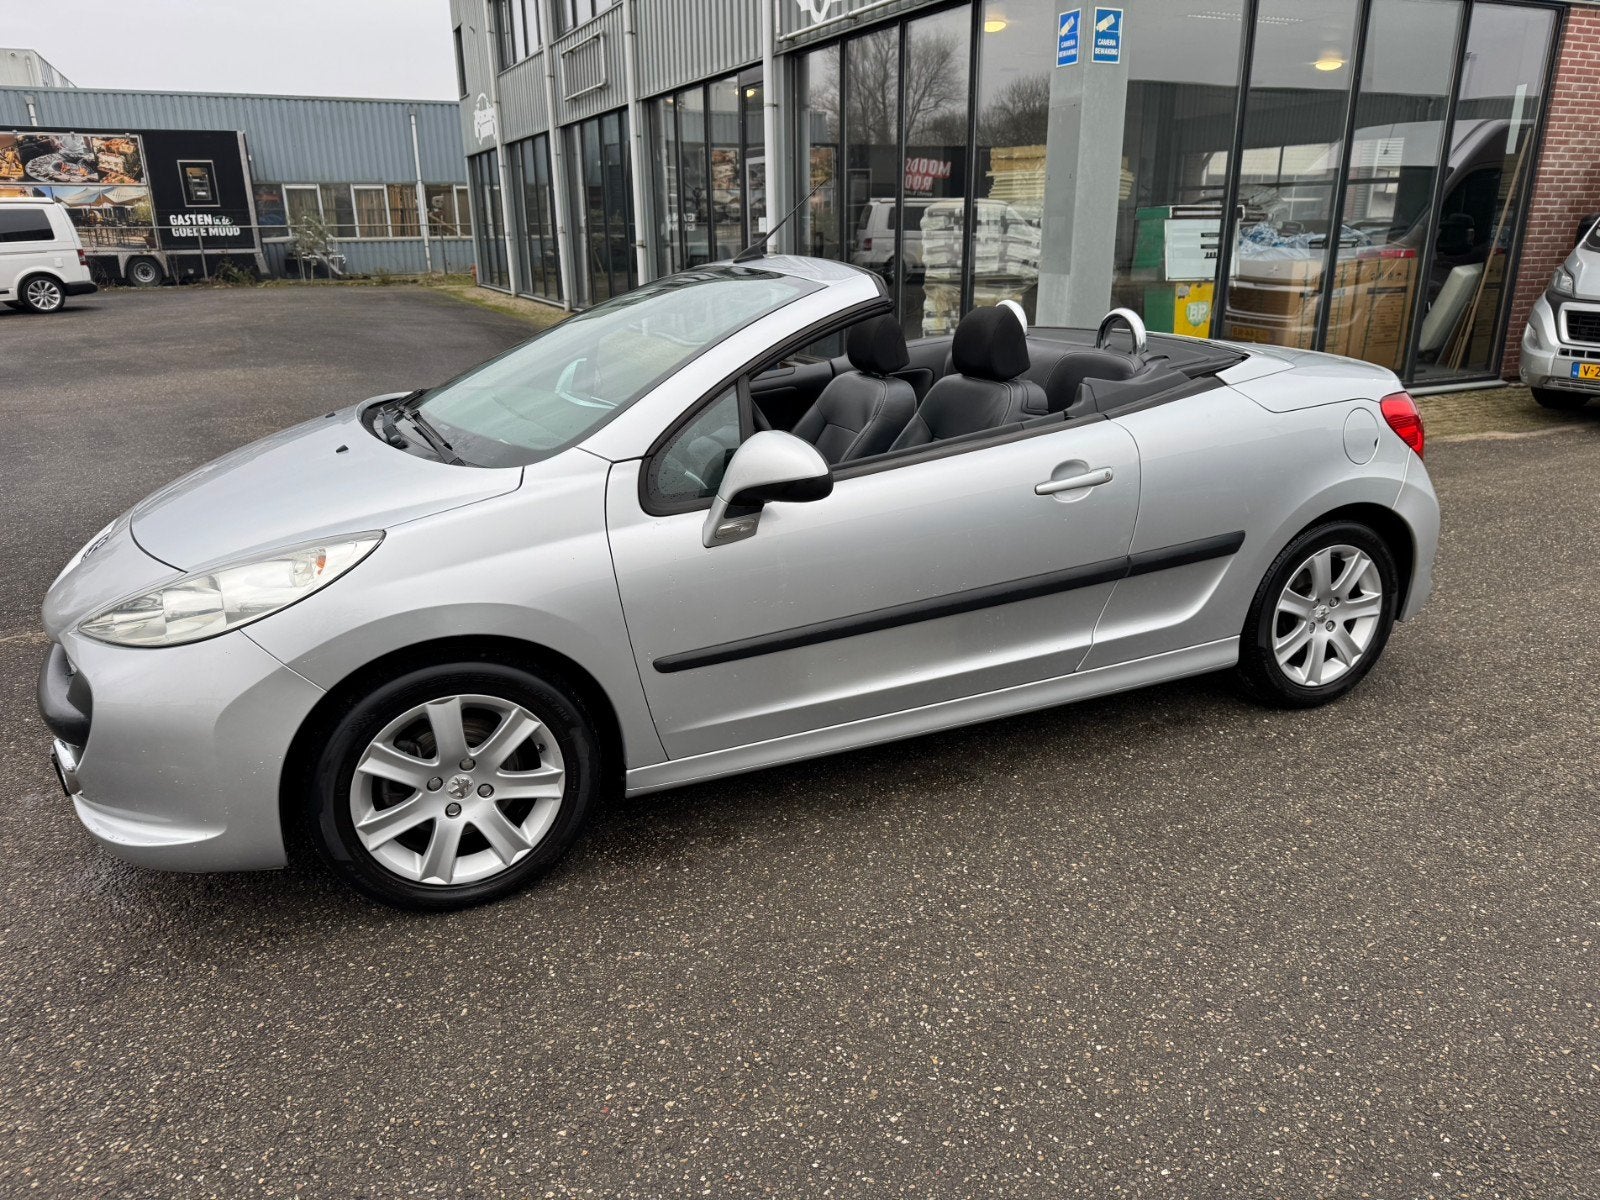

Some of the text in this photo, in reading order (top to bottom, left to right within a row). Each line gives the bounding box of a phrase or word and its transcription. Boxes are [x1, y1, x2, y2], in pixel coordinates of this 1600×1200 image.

[1097, 38, 1116, 46] CAMERA
[1094, 47, 1118, 55] BEWAKING
[169, 213, 213, 225] GASTEN
[208, 224, 240, 236] MOOD
[1188, 304, 1208, 320] BP
[1583, 365, 1600, 377] V-2
